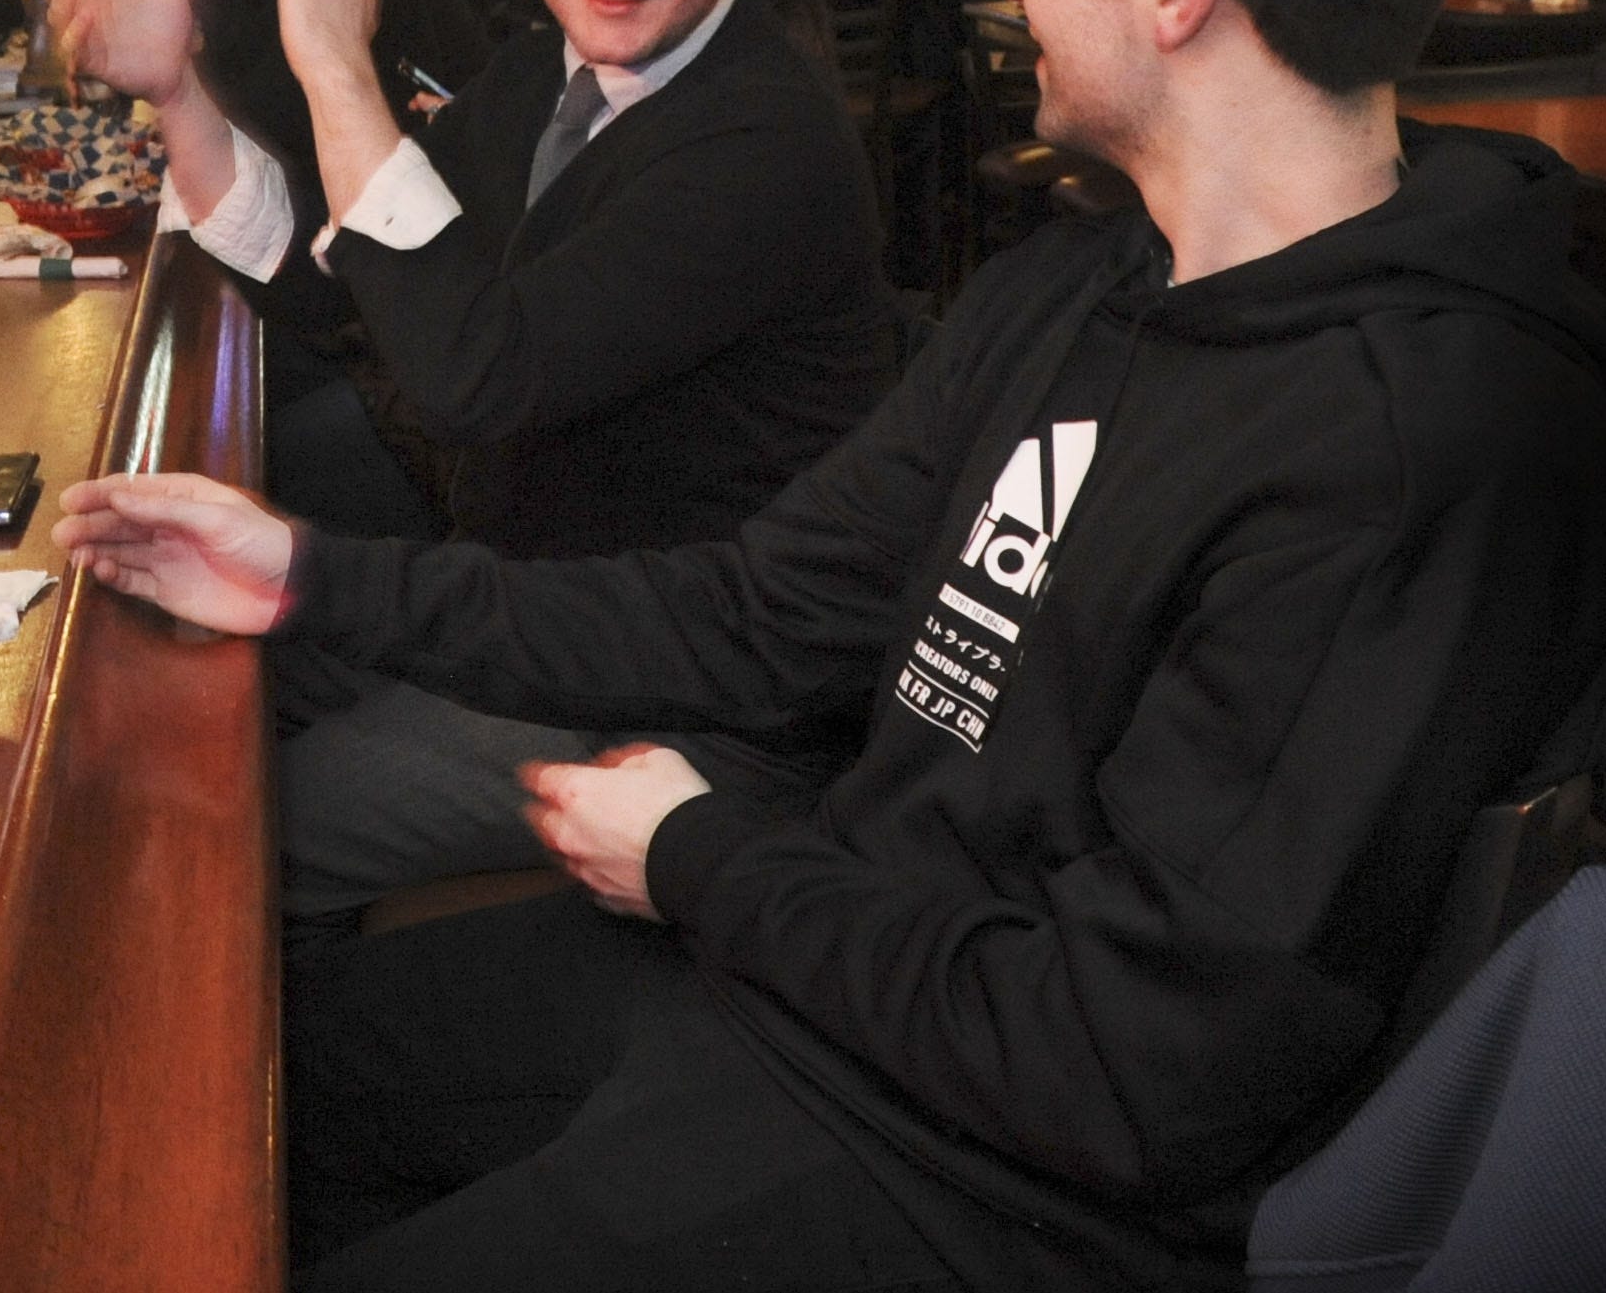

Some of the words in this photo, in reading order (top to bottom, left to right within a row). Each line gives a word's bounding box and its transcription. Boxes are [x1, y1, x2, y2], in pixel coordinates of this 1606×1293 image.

[909, 678, 931, 707] FR
[930, 697, 956, 718] JP
[970, 675, 999, 702] ONLY
